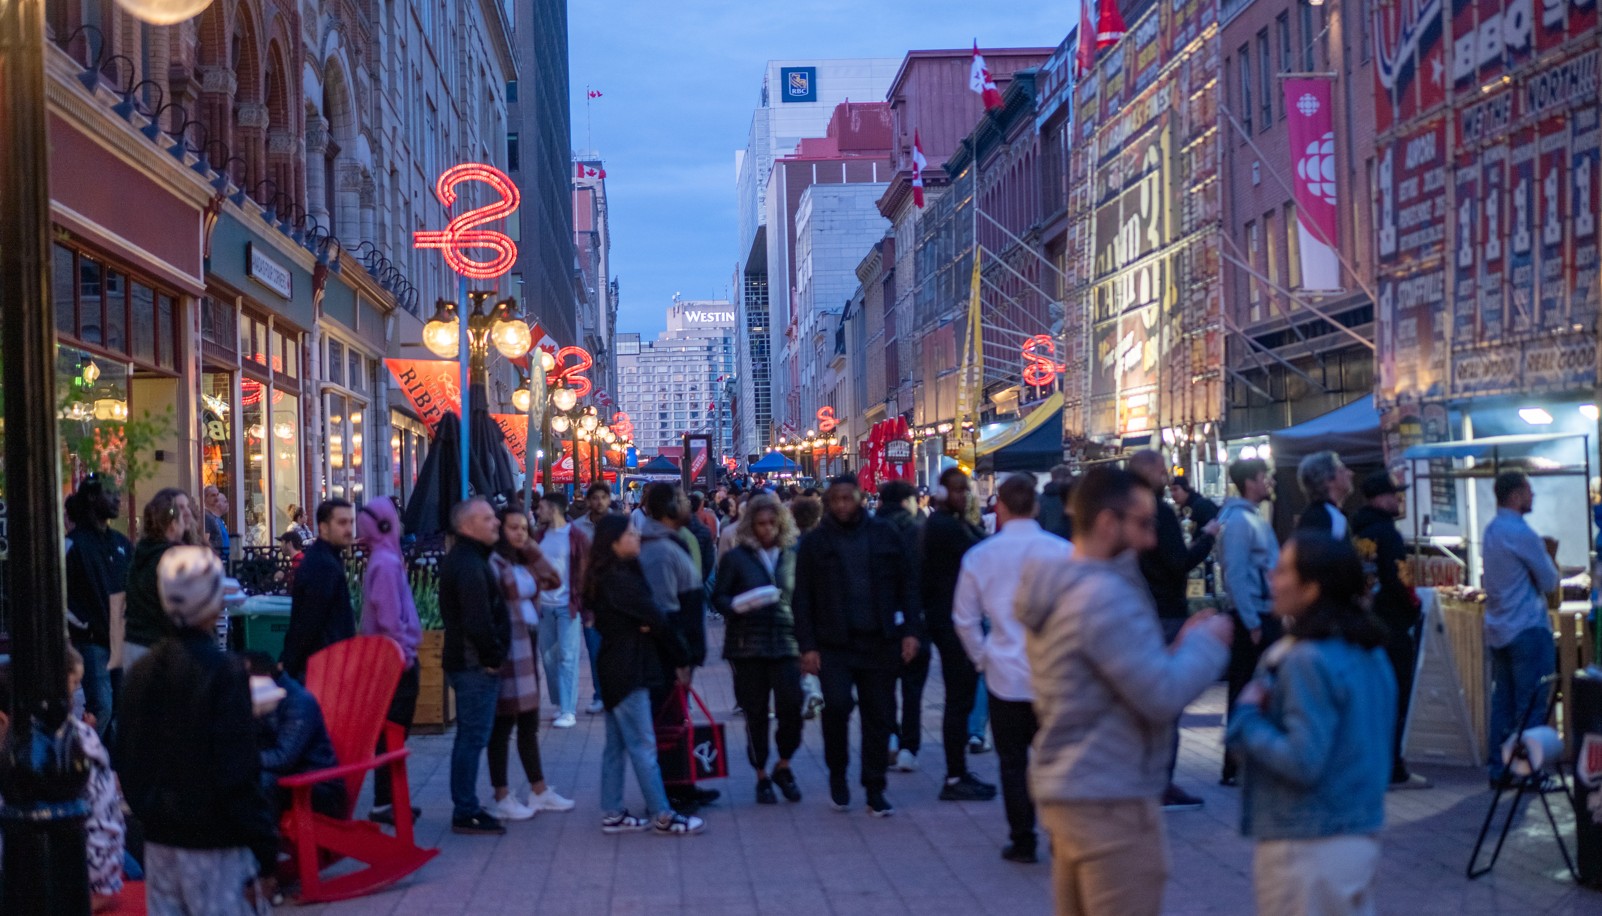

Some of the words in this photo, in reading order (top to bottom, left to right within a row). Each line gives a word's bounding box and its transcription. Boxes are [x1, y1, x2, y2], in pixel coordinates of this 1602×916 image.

[1454, 0, 1533, 81] BBQ
[1380, 148, 1396, 256] 1
[1459, 198, 1472, 267] 1
[1485, 188, 1500, 260] 1
[1513, 179, 1530, 252] 1
[1544, 167, 1560, 245] 1
[1576, 156, 1593, 237] 1
[685, 311, 735, 322] WESTIN
[1557, 346, 1596, 371] GOOD
[399, 367, 442, 432] RIBFE
[498, 419, 527, 465] RIBFE
